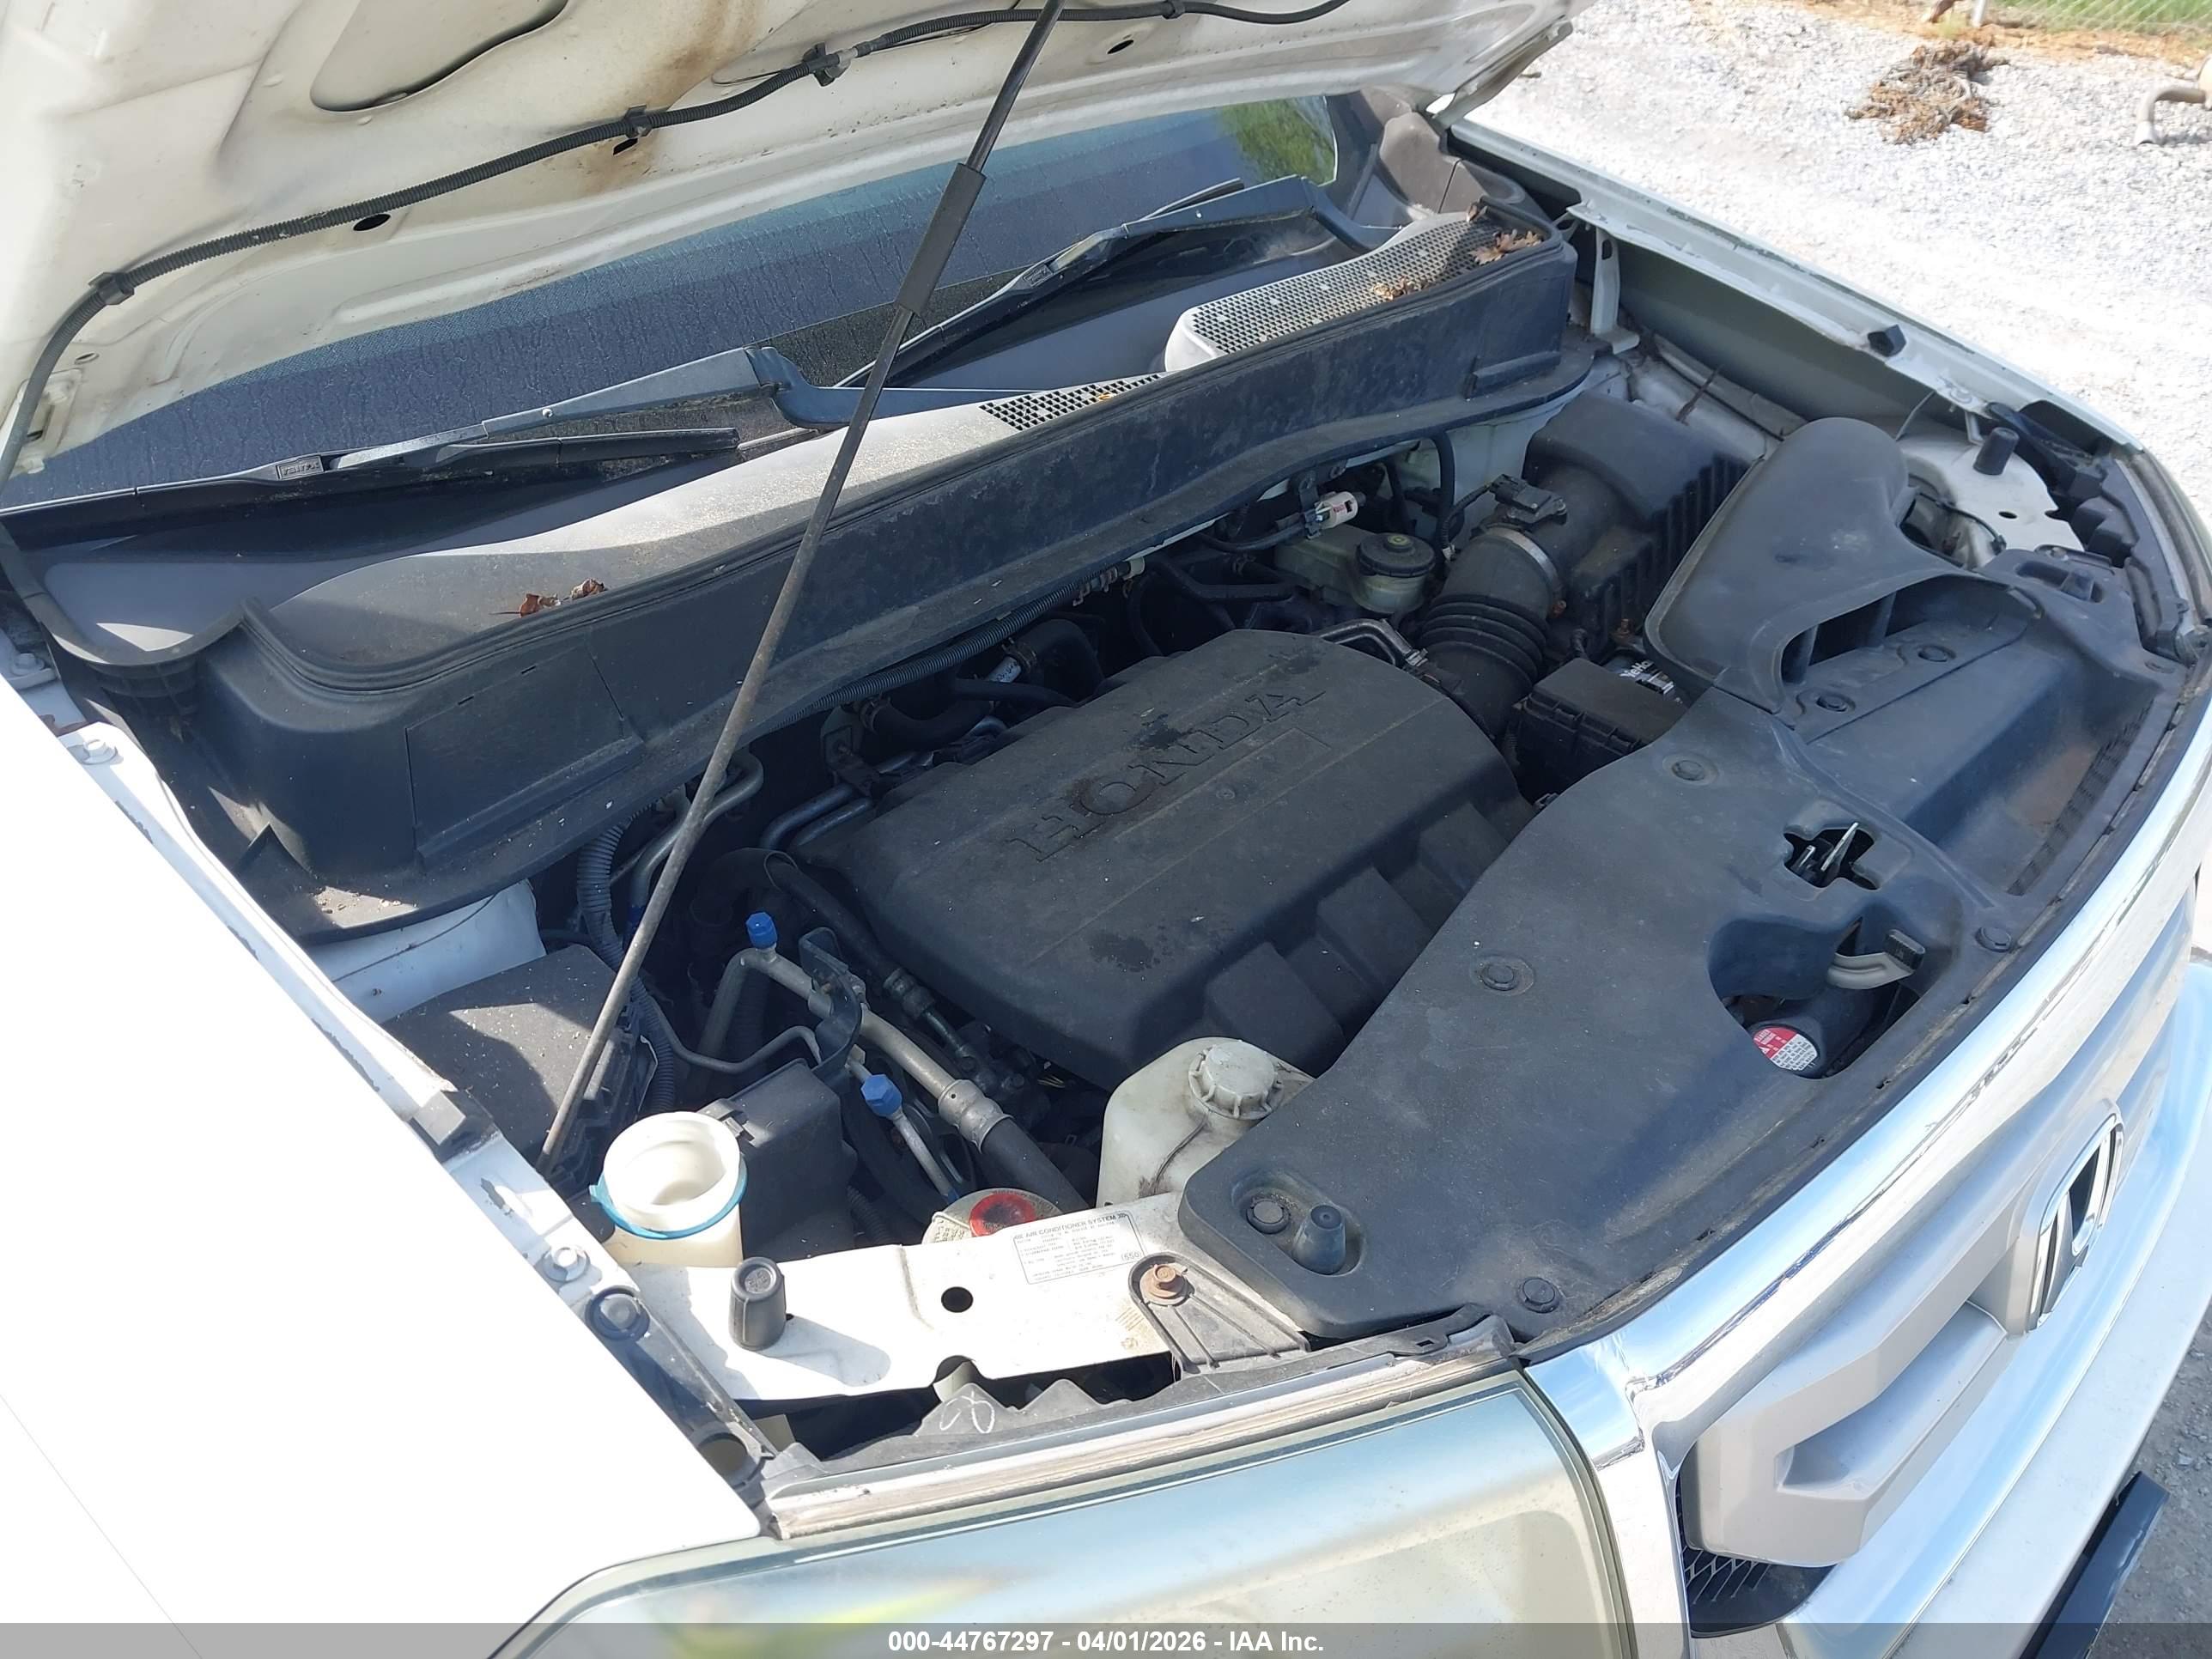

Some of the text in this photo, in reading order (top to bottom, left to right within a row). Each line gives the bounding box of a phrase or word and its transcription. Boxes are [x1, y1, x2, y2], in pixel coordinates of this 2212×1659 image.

[1006, 690, 1327, 862] HONDA
[1038, 1221, 1086, 1236] CONDITIONER
[1086, 1214, 1116, 1226] SYSTEM
